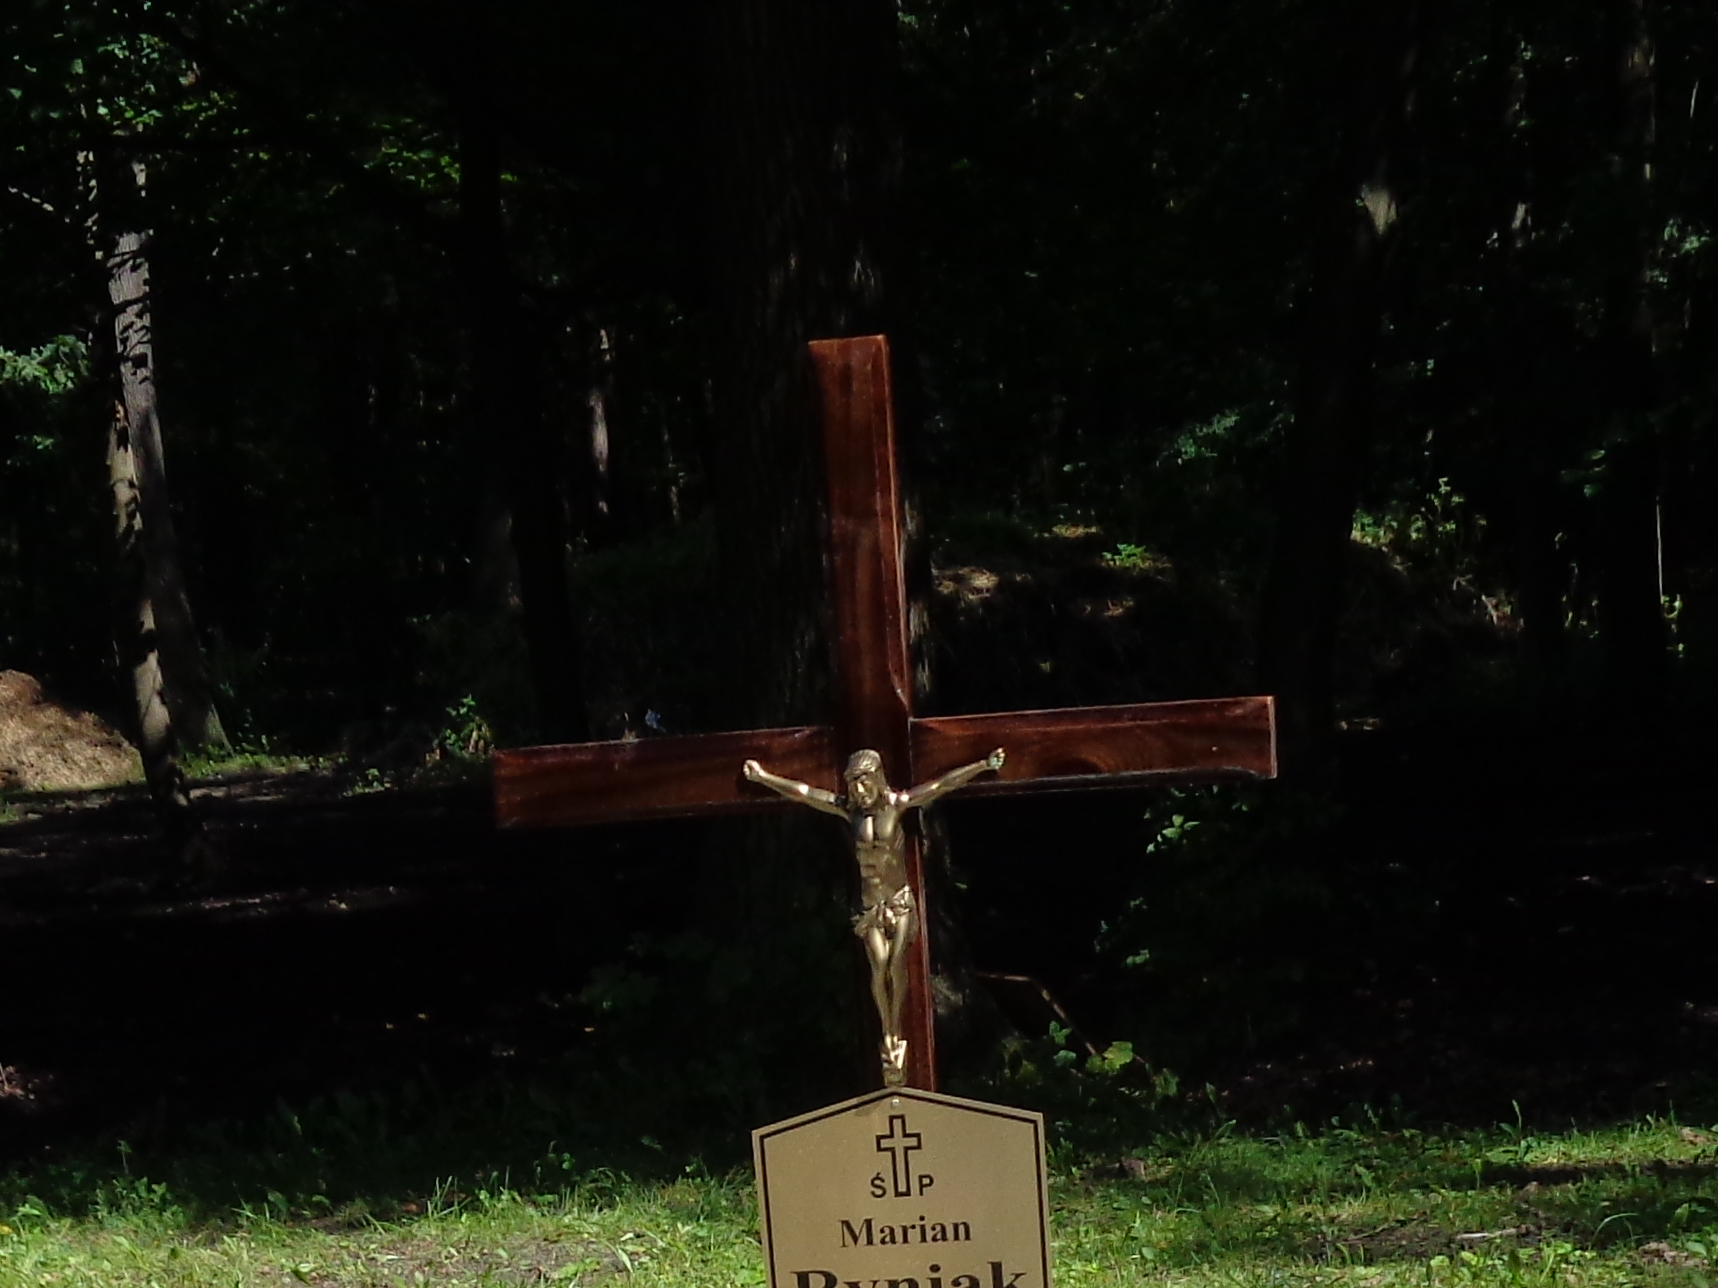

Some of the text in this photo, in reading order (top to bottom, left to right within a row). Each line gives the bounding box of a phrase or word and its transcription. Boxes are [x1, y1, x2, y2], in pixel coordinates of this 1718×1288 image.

[870, 1171, 935, 1199] Ś P
[839, 1215, 973, 1248] Marian
